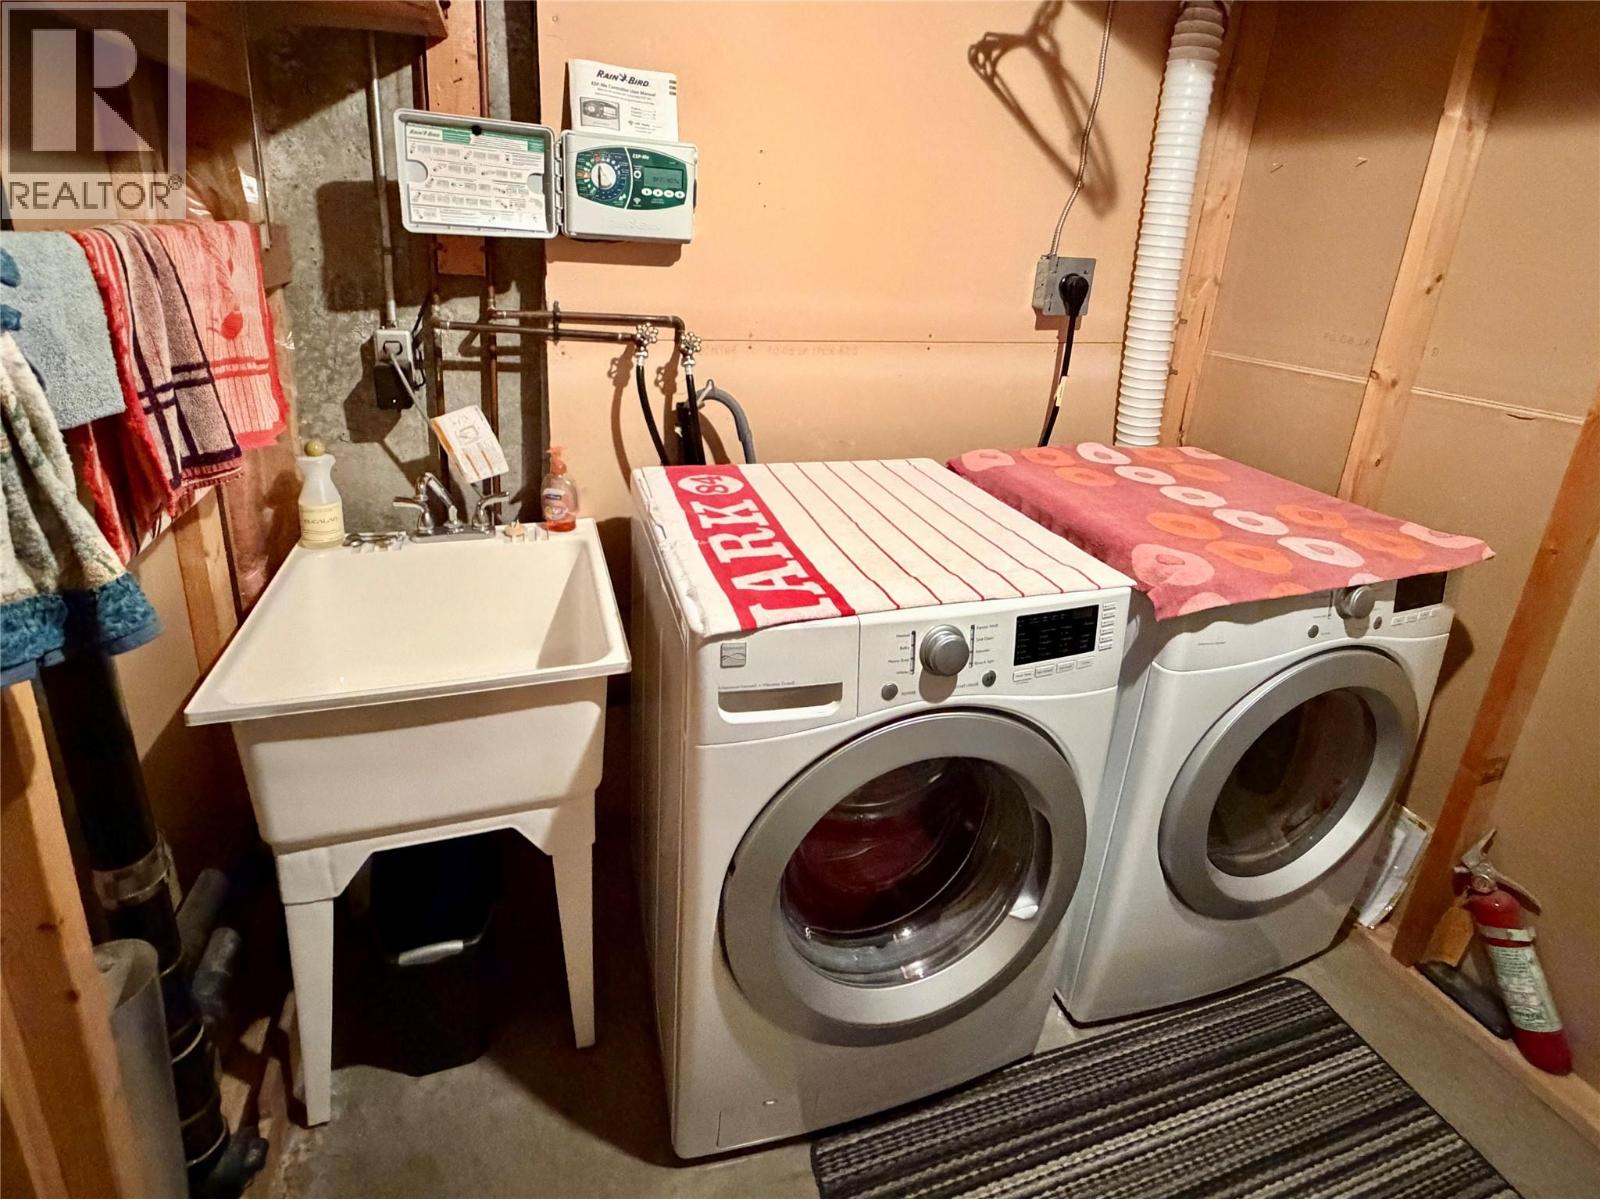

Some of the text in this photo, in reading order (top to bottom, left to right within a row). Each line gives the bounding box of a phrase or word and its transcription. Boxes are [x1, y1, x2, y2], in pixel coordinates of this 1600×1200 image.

[596, 69, 650, 87] RAIN BIRD
[690, 475, 729, 495] 84
